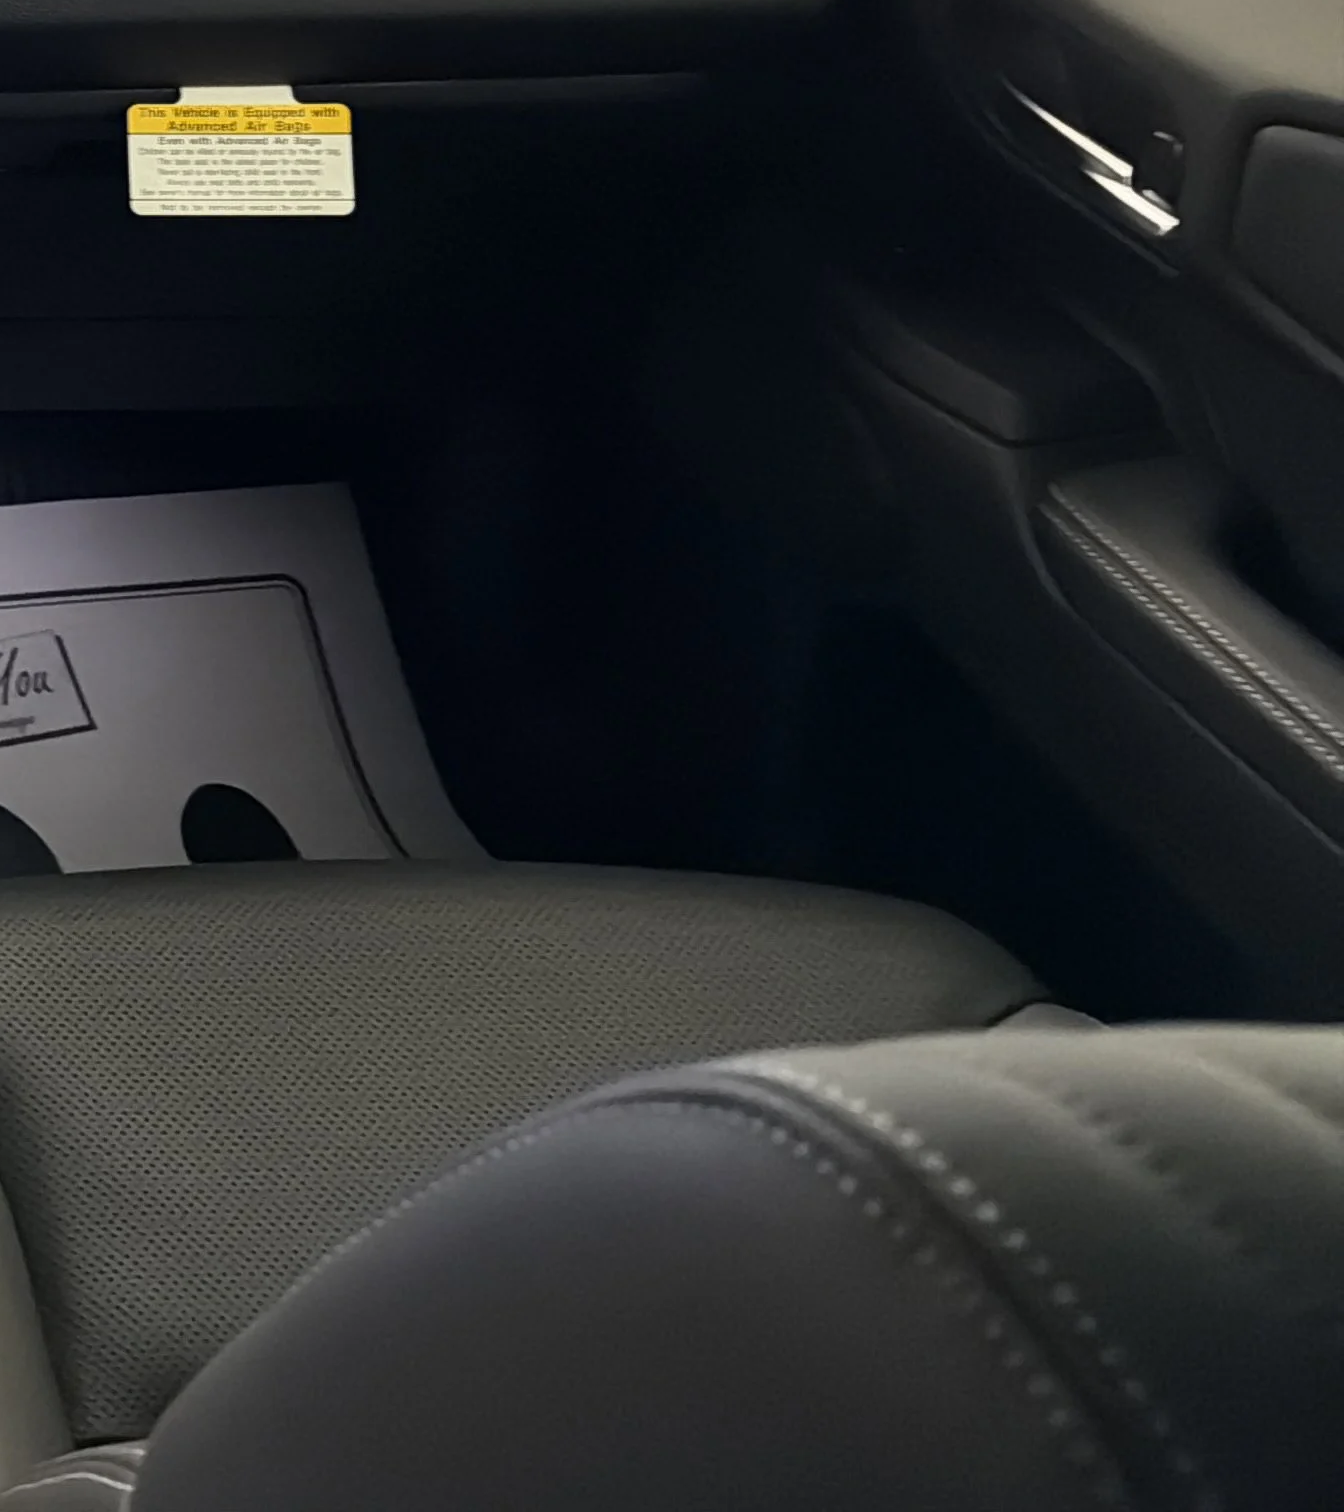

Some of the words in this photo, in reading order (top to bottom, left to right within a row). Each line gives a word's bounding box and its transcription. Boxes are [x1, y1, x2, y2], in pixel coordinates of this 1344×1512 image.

[139, 107, 167, 118] This
[172, 107, 220, 118] Vehicle
[224, 107, 239, 118] is
[243, 106, 306, 120] Equipped
[310, 106, 341, 118] with
[166, 120, 238, 131] Advanced
[244, 120, 268, 131] Air
[274, 120, 312, 133] Bags
